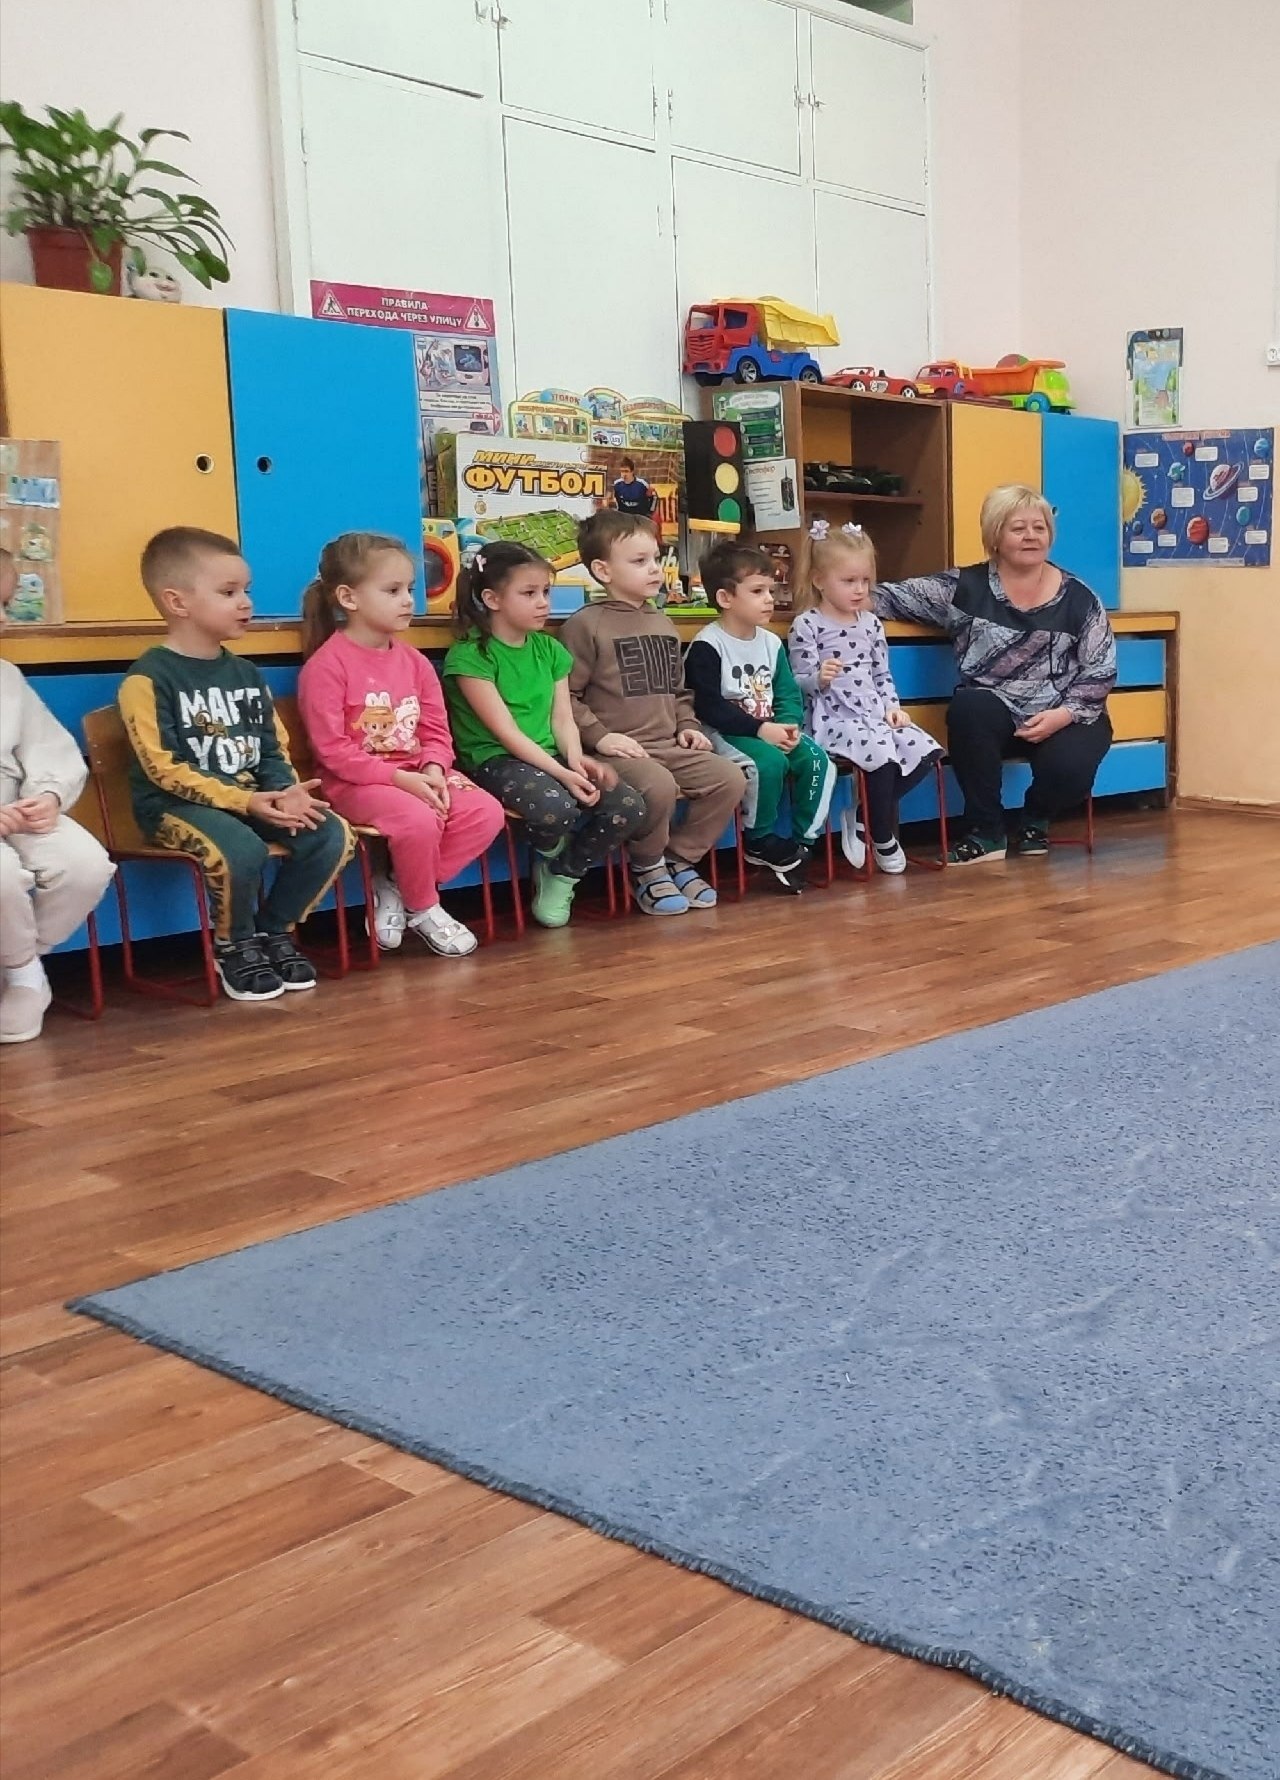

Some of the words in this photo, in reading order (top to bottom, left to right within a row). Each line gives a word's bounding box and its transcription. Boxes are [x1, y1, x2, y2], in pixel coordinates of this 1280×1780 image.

[381, 297, 429, 311] ПРАВИЛА
[346, 307, 399, 322] ПЕРЕХОДА
[400, 312, 428, 323] ЧЕРЕЗ
[430, 315, 462, 327] УЛИЦУ
[464, 465, 606, 497] ФУТБОЛ
